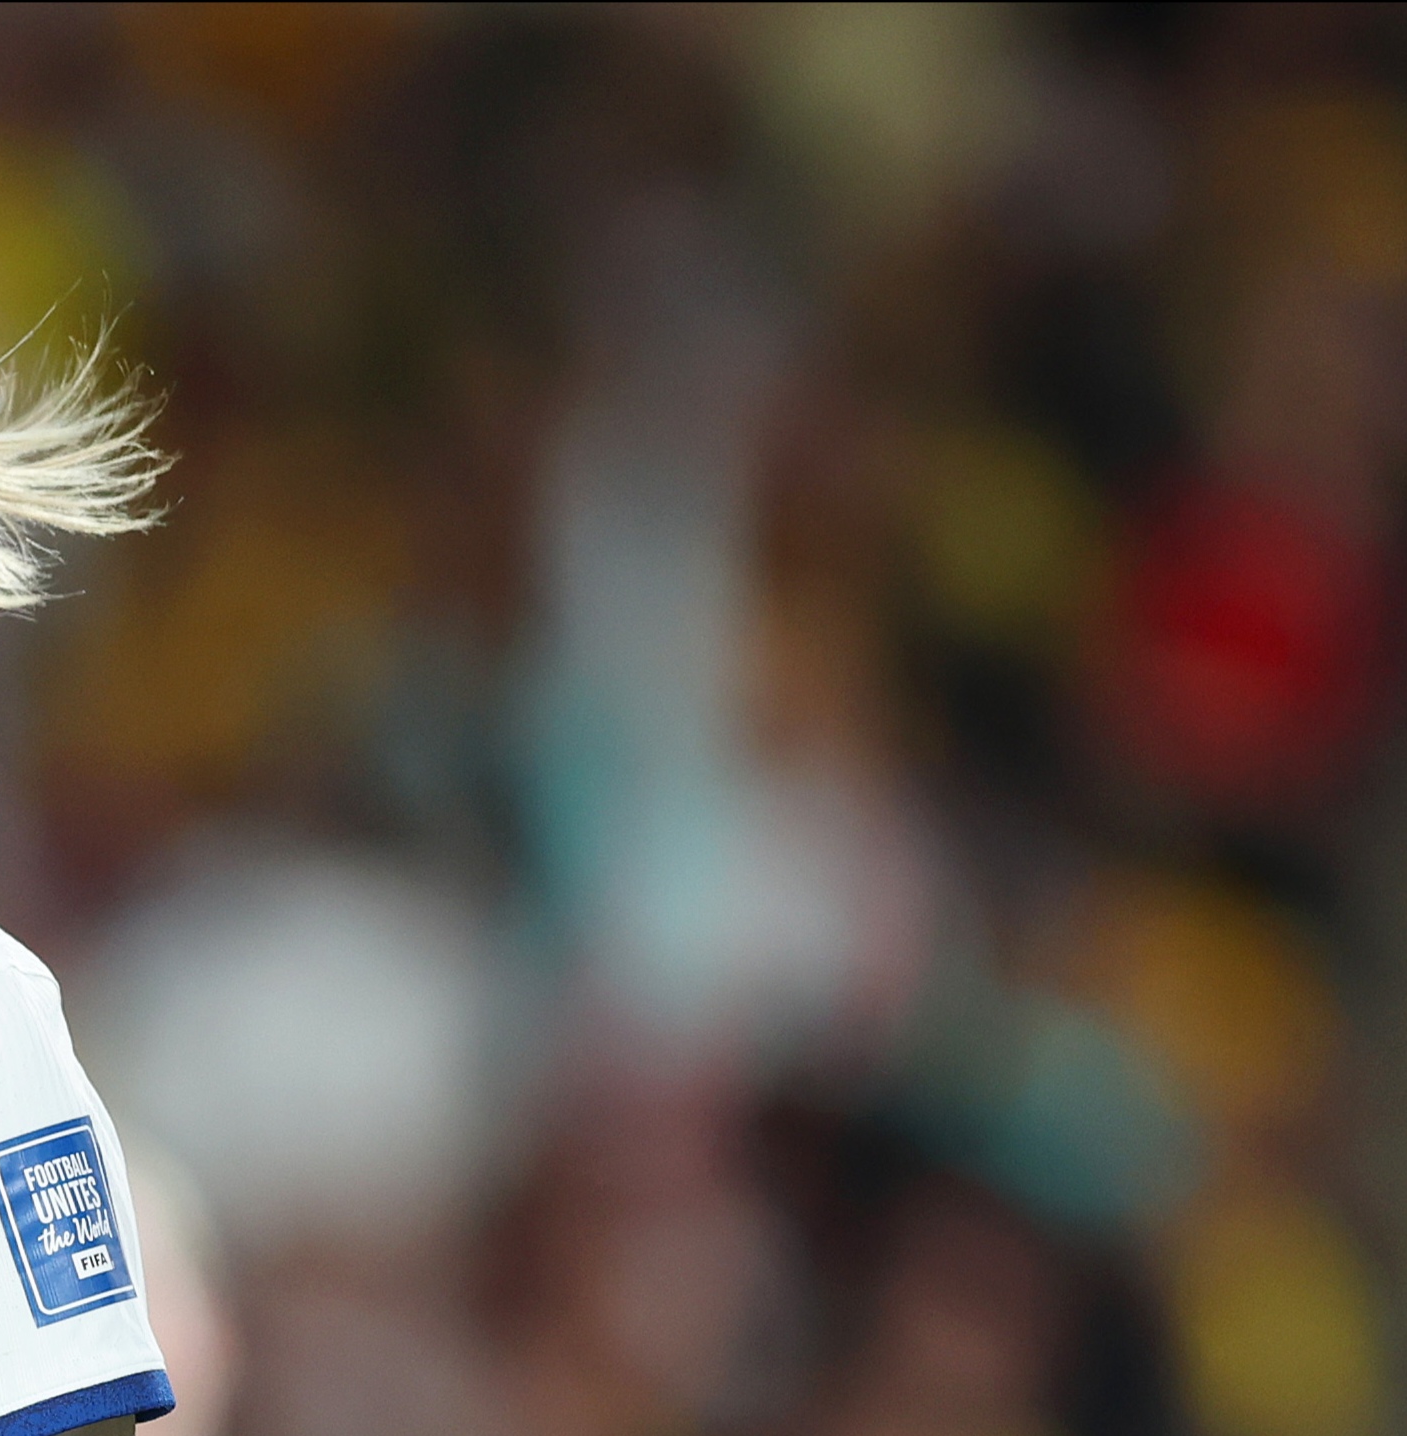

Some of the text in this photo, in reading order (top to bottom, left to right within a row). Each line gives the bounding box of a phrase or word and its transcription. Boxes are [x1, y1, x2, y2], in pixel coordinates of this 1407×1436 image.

[23, 1150, 93, 1192] FOOTBALL
[31, 1176, 102, 1225] UNITES
[37, 1208, 113, 1257] the World
[80, 1252, 108, 1271] FIFA
